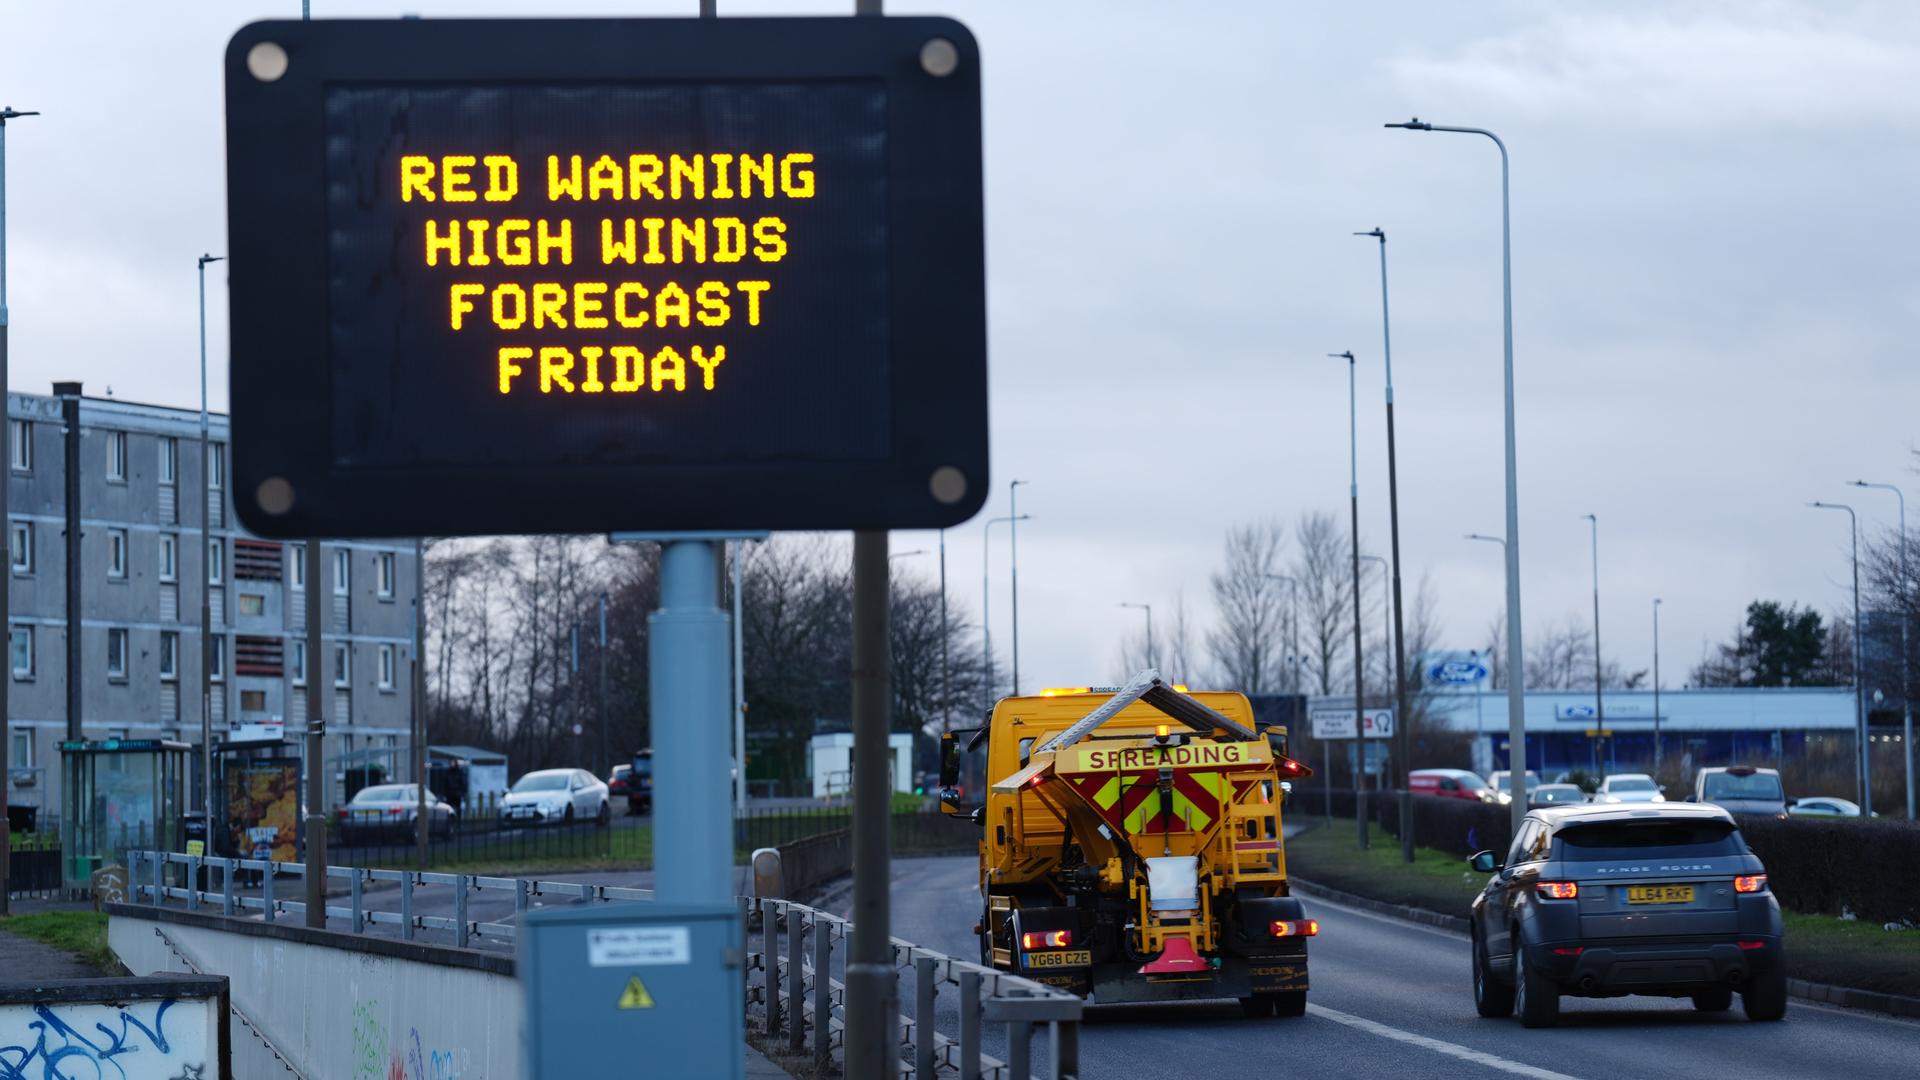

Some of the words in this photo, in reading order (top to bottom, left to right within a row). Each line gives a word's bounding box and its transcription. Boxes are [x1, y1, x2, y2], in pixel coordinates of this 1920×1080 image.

[402, 156, 517, 201] RED
[548, 153, 814, 200] WARNING
[426, 220, 572, 266] HIGH
[602, 217, 786, 264] WINDS
[451, 281, 770, 329] FORECAST
[499, 346, 725, 393] FRIDAY
[1090, 745, 1240, 768] SPREADING
[1628, 888, 1662, 901] LL64
[1030, 953, 1062, 966] YG68
[1065, 952, 1089, 965] CZE
